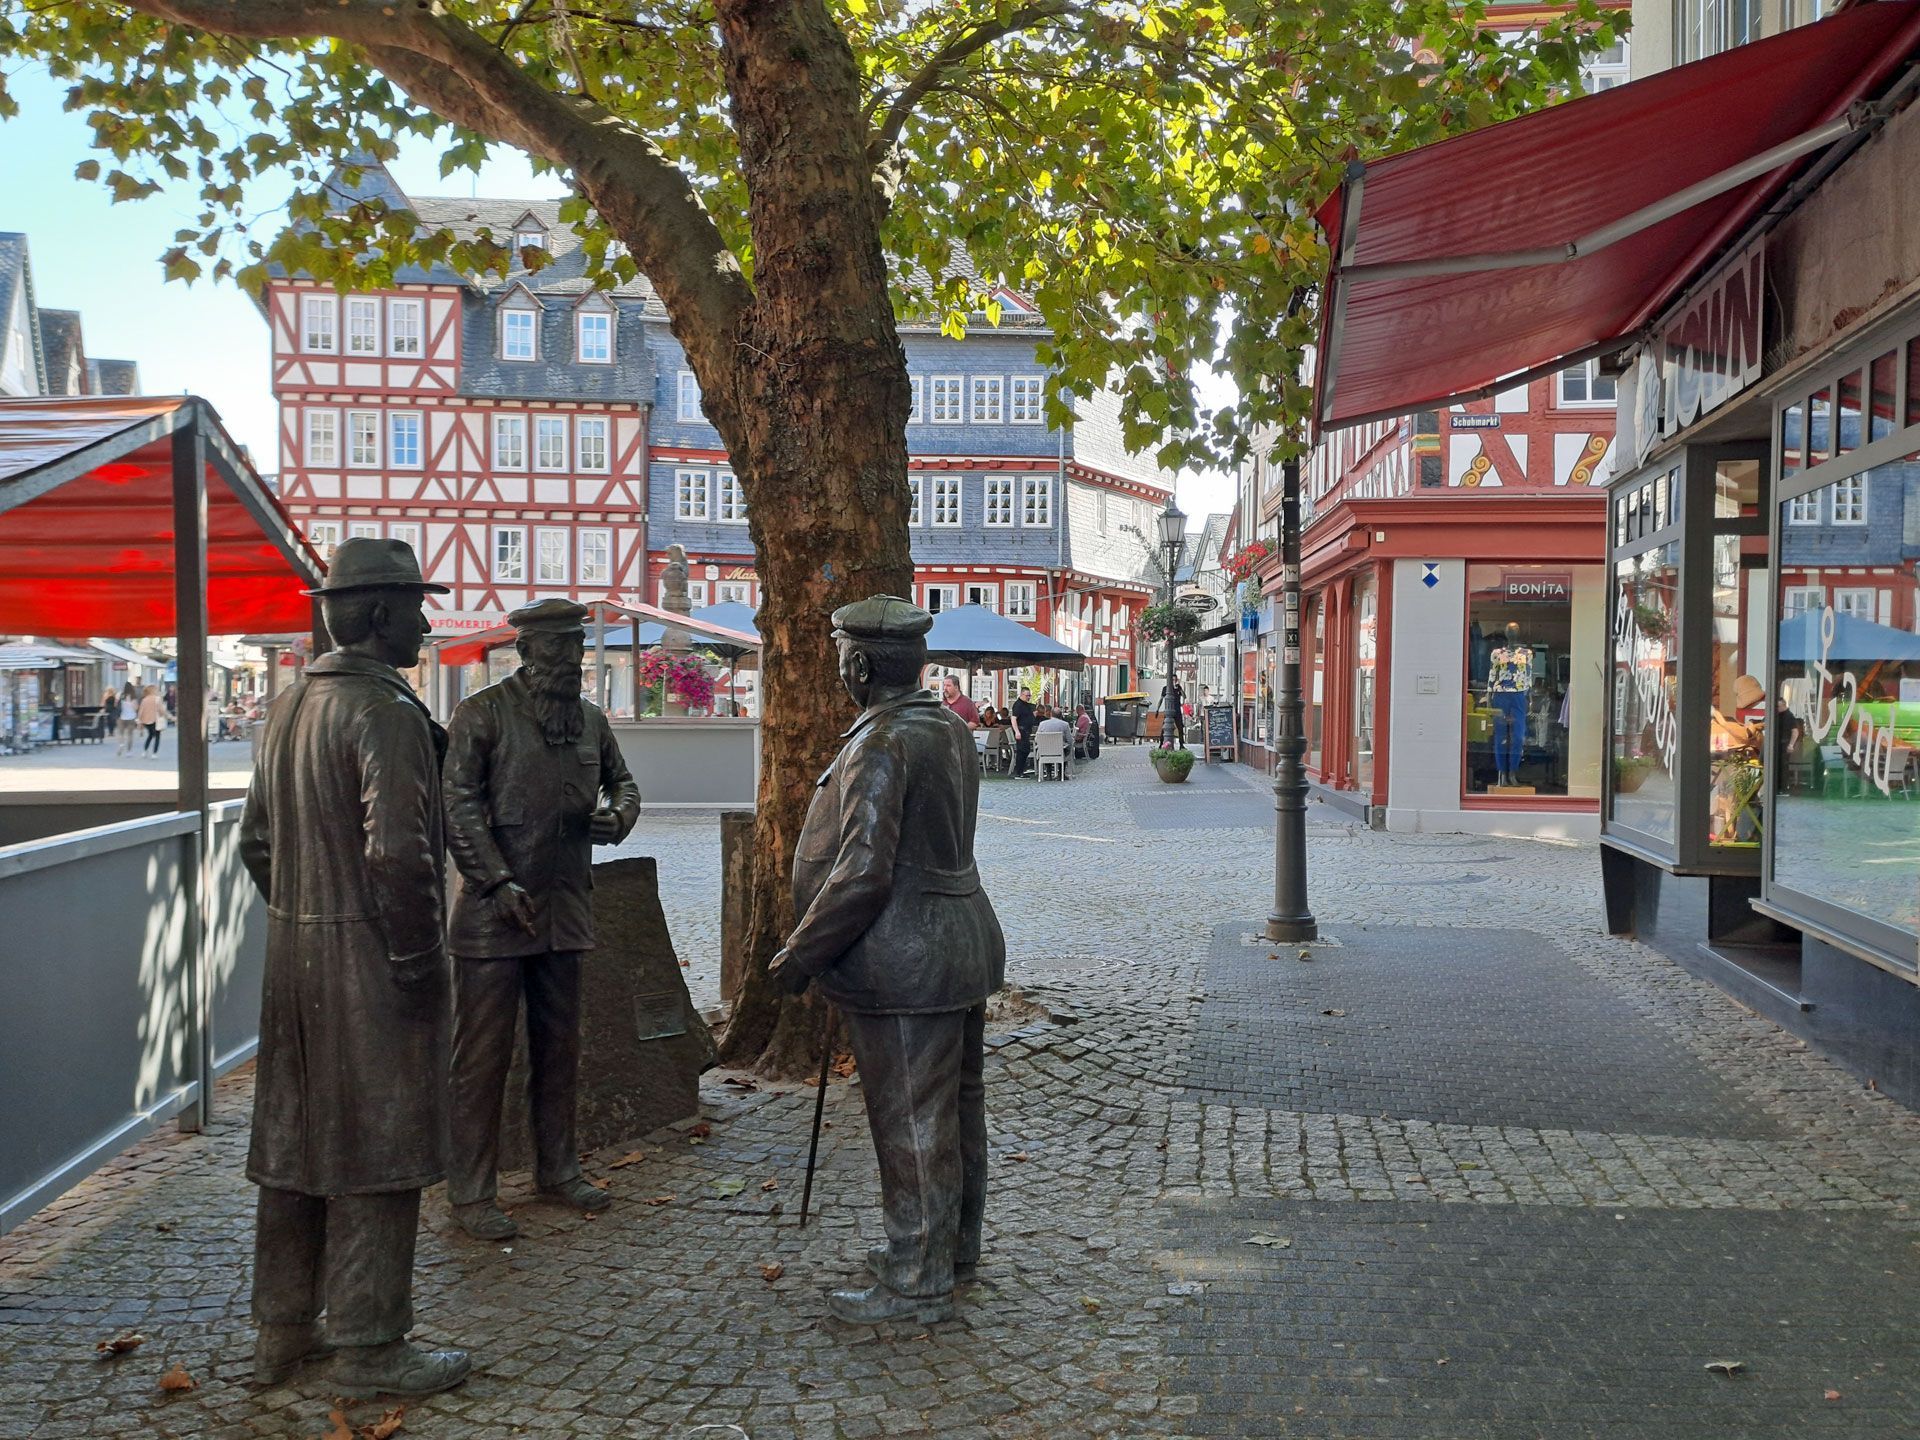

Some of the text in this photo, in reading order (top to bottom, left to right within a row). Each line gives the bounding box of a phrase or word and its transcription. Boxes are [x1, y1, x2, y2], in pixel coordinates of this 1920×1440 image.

[1664, 240, 1764, 437] TOWN
[430, 617, 491, 629] RFÜMERIE
[1509, 581, 1565, 598] BONITA
[1836, 671, 1895, 797] 2nd
